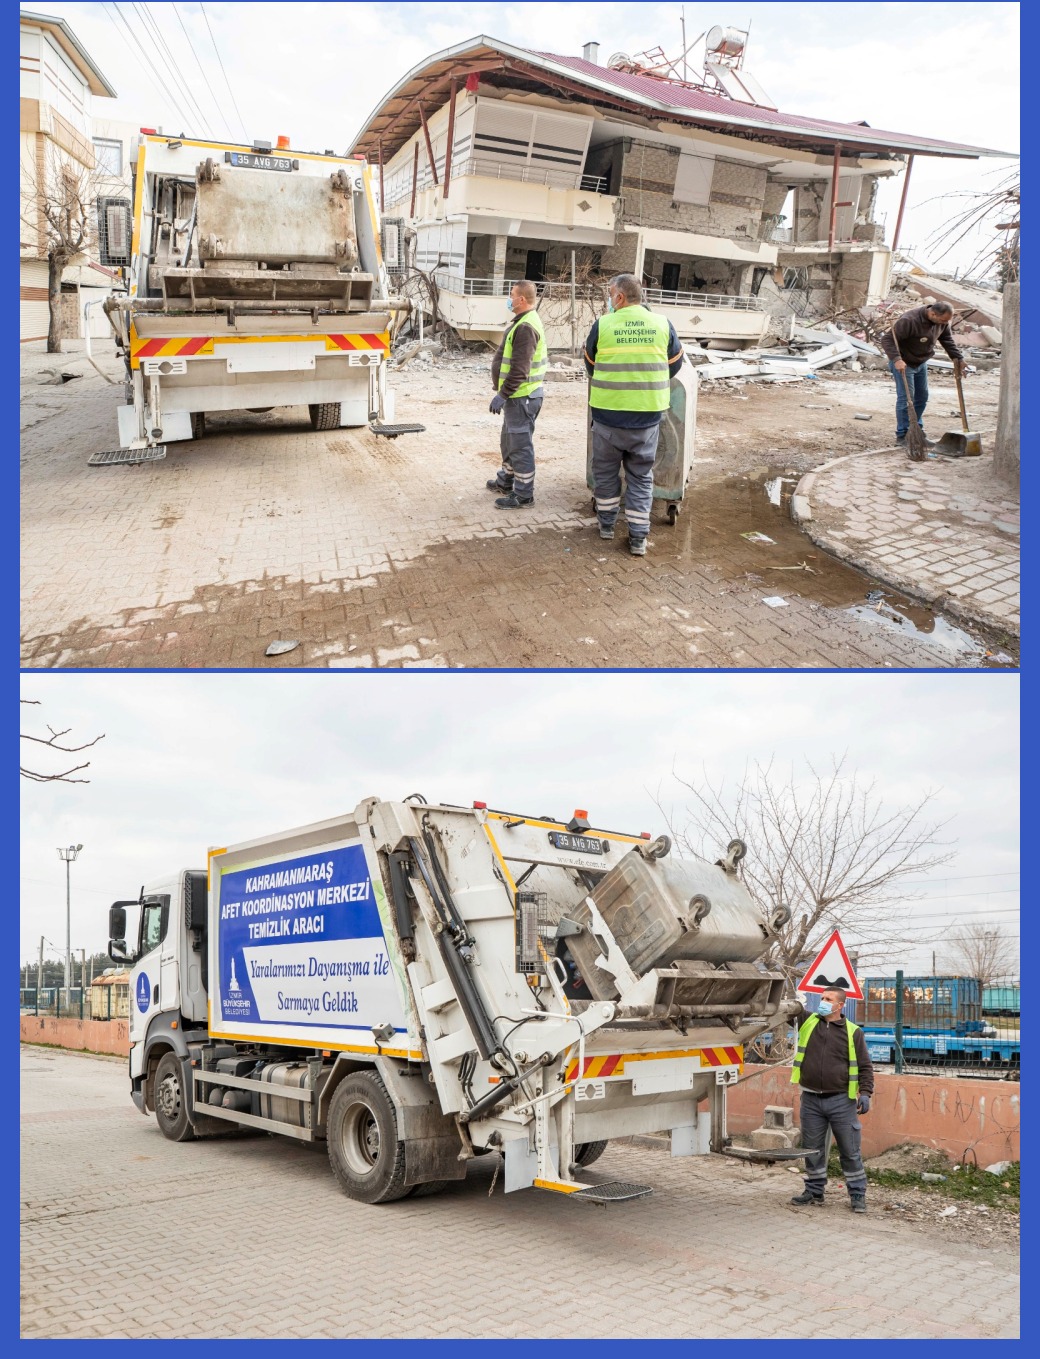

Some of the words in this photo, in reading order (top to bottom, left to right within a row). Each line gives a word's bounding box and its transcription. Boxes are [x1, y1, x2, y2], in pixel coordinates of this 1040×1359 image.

[237, 155, 249, 164] 35
[254, 156, 271, 167] AVG
[273, 159, 290, 169] 763
[613, 328, 657, 337] BÜYÜKŞEHİR
[625, 319, 645, 327] İZMİR
[616, 336, 655, 344] BELEDİYESİ
[558, 834, 569, 846] 35
[572, 837, 585, 849] AVG
[586, 839, 600, 851] 763
[245, 861, 334, 894] KAHRAMANMARAŞ
[221, 902, 241, 920] AFET
[241, 892, 314, 917] KOORDİNASYON
[316, 877, 370, 907] MERKEZİ
[248, 916, 291, 939] TEMİZLİK
[292, 915, 324, 935] ARACI
[250, 959, 306, 978] Yaralarımızı
[307, 957, 370, 982] Dayanışma
[373, 953, 389, 976] ile
[277, 991, 320, 1016] Sarmaya
[322, 991, 359, 1013] Geldik
